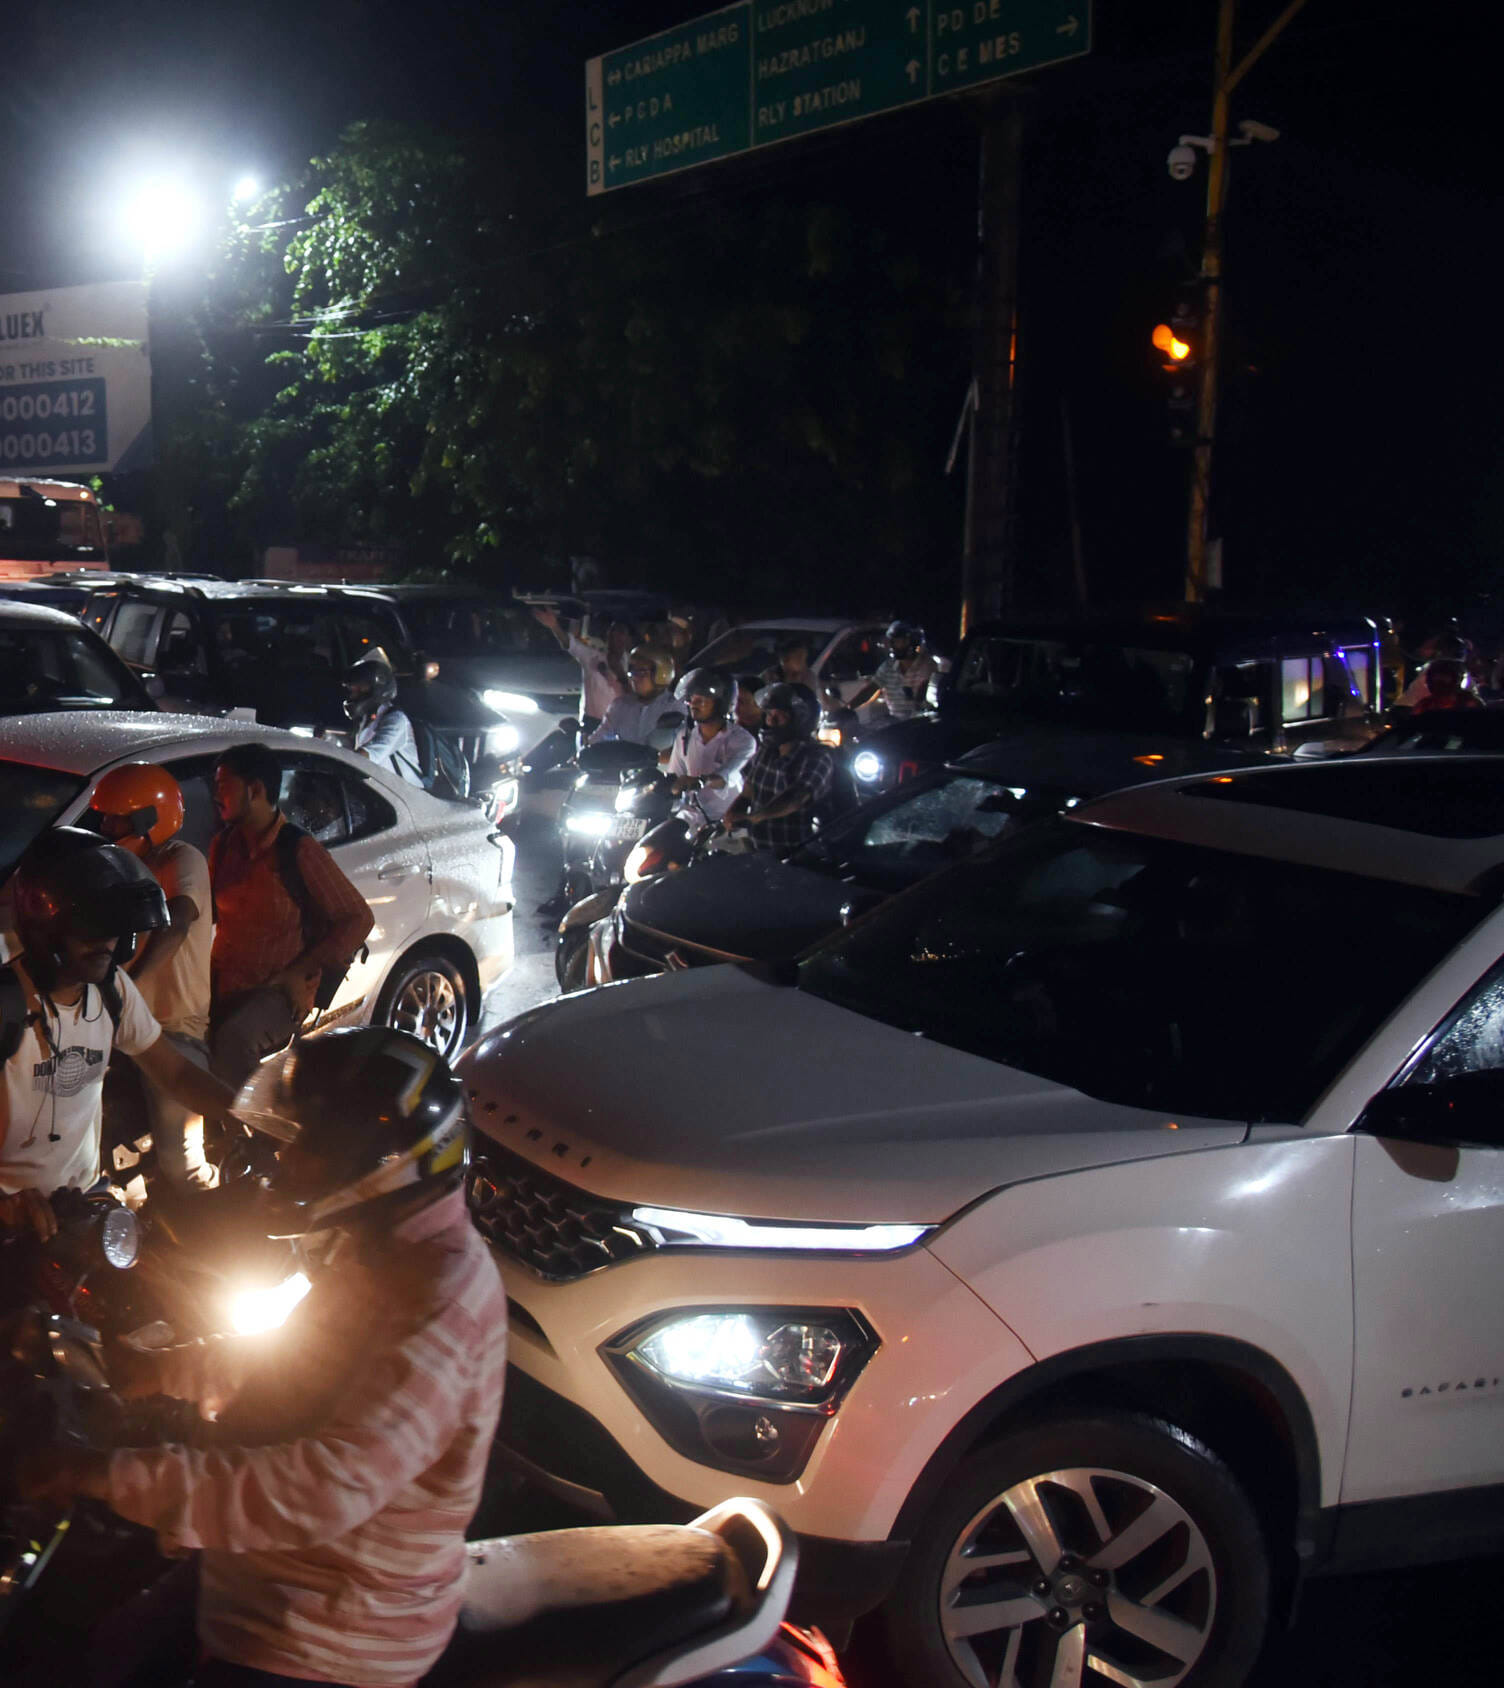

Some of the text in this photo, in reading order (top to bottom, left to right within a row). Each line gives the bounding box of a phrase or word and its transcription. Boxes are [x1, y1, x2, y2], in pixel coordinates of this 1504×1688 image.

[624, 24, 740, 80] CARIAPPA MARG
[759, 25, 865, 80] HAZRATGANJ
[979, 32, 1021, 64] MES
[759, 79, 862, 128] RLY STATION
[625, 124, 720, 168] RLY HOSPITAL
[20, 360, 56, 379] THIS
[60, 356, 95, 376] SITE
